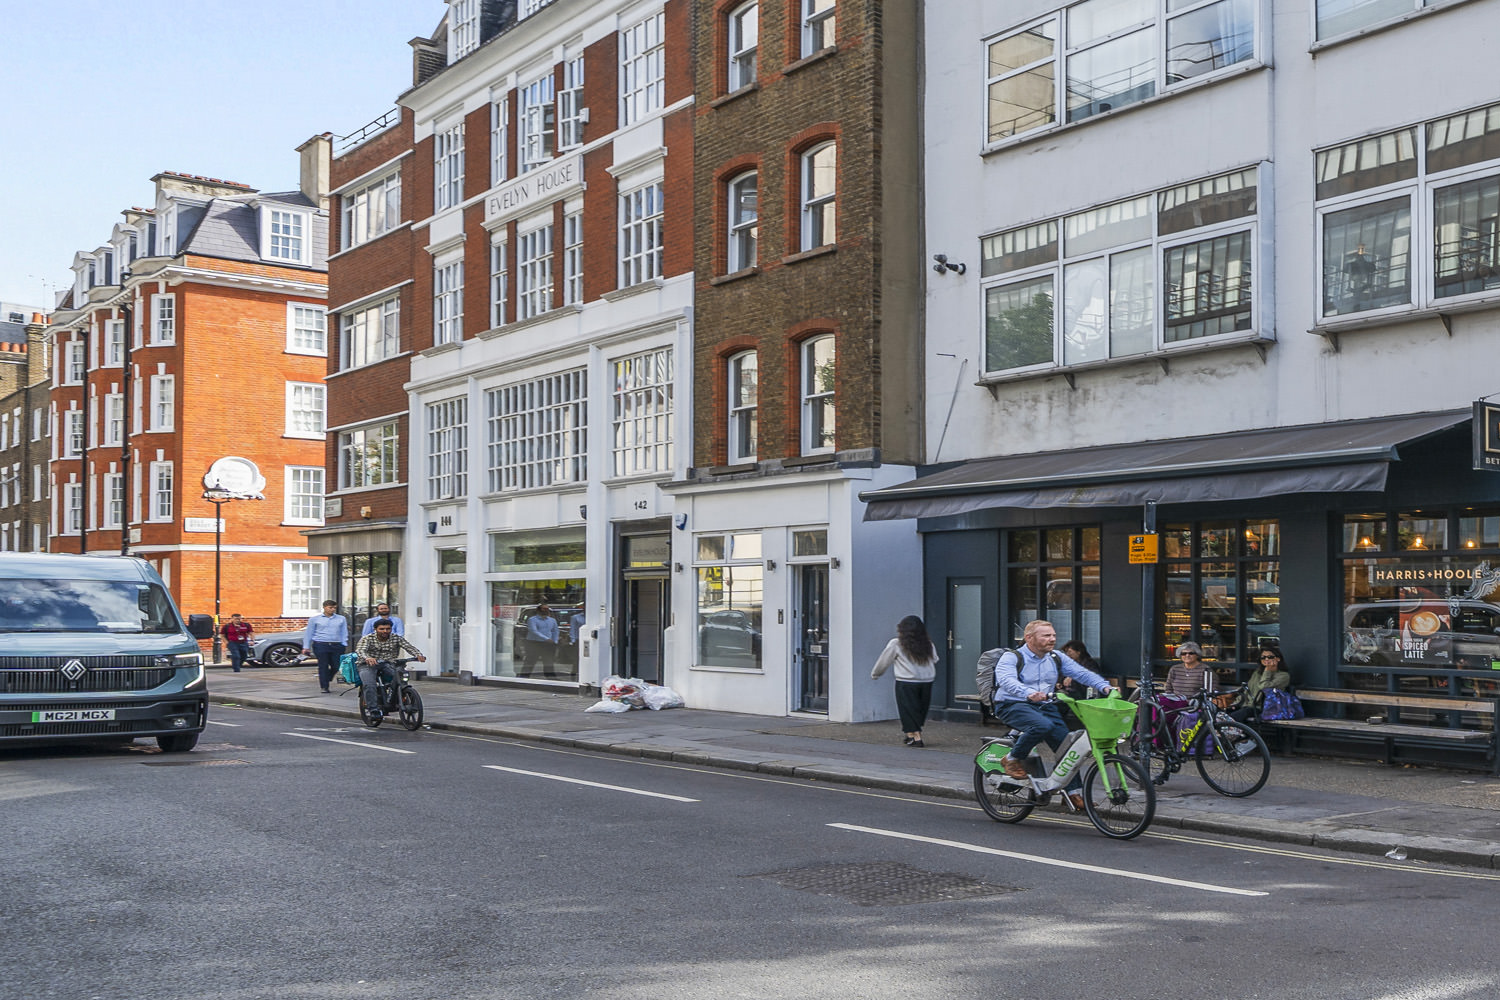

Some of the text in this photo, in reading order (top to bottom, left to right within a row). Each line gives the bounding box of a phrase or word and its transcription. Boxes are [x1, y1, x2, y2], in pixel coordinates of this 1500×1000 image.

[490, 163, 573, 215] EVELYN HOUSE
[634, 500, 648, 510] 142
[1376, 569, 1482, 580] HARRIS+HOOLE
[1404, 642, 1429, 651] SPICED
[1404, 650, 1425, 659] LATTE
[44, 710, 110, 721] MG21 MGX
